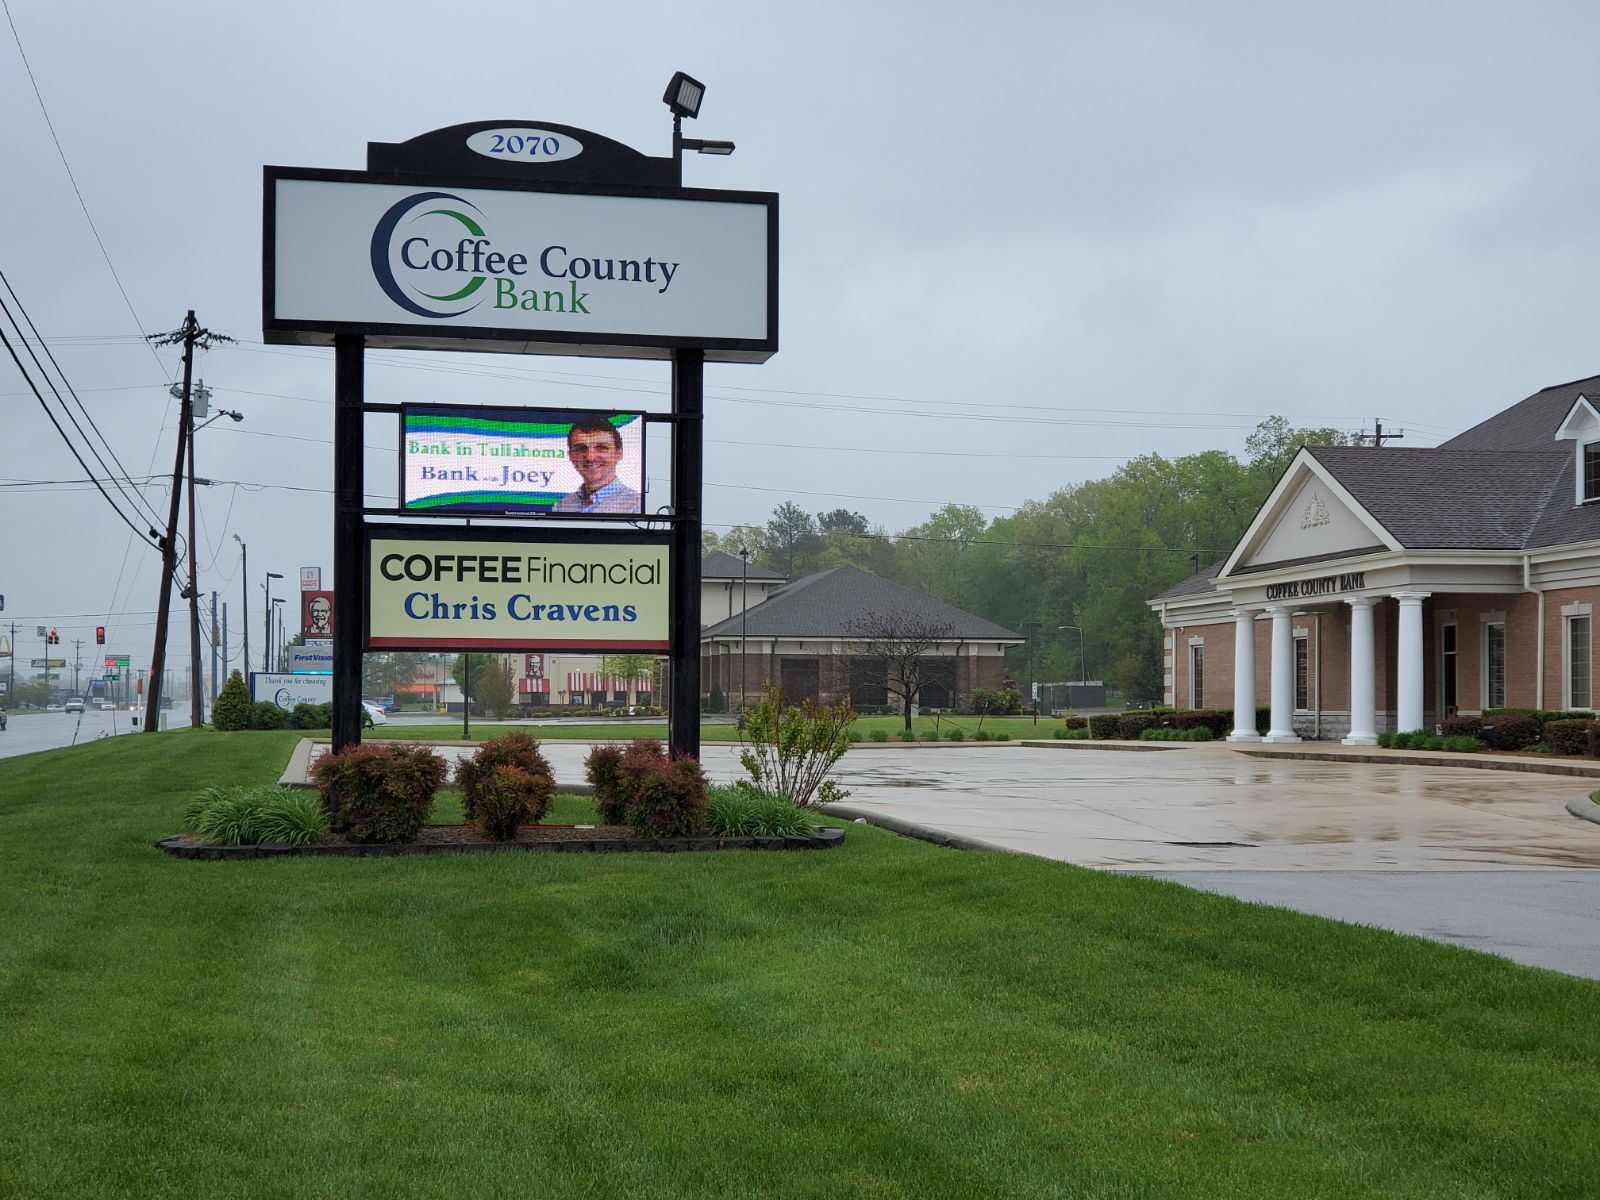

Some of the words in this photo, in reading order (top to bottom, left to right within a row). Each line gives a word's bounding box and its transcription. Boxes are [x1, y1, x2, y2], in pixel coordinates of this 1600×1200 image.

[489, 134, 560, 156] 2070
[401, 237, 527, 275] Coffee
[540, 245, 680, 293] County
[493, 278, 591, 314] Bank
[409, 440, 450, 454] Bank
[456, 442, 472, 455] in
[478, 443, 565, 458] Tullahoma
[421, 466, 478, 481] Bank
[500, 466, 554, 487] Joey
[380, 554, 521, 583] COFFEE
[528, 557, 660, 584] Financial
[1267, 582, 1298, 599] COFFEE
[1301, 577, 1337, 595] COUNTY
[1340, 572, 1365, 591] BANK
[405, 592, 496, 620] Chris
[507, 594, 637, 622] Cravens
